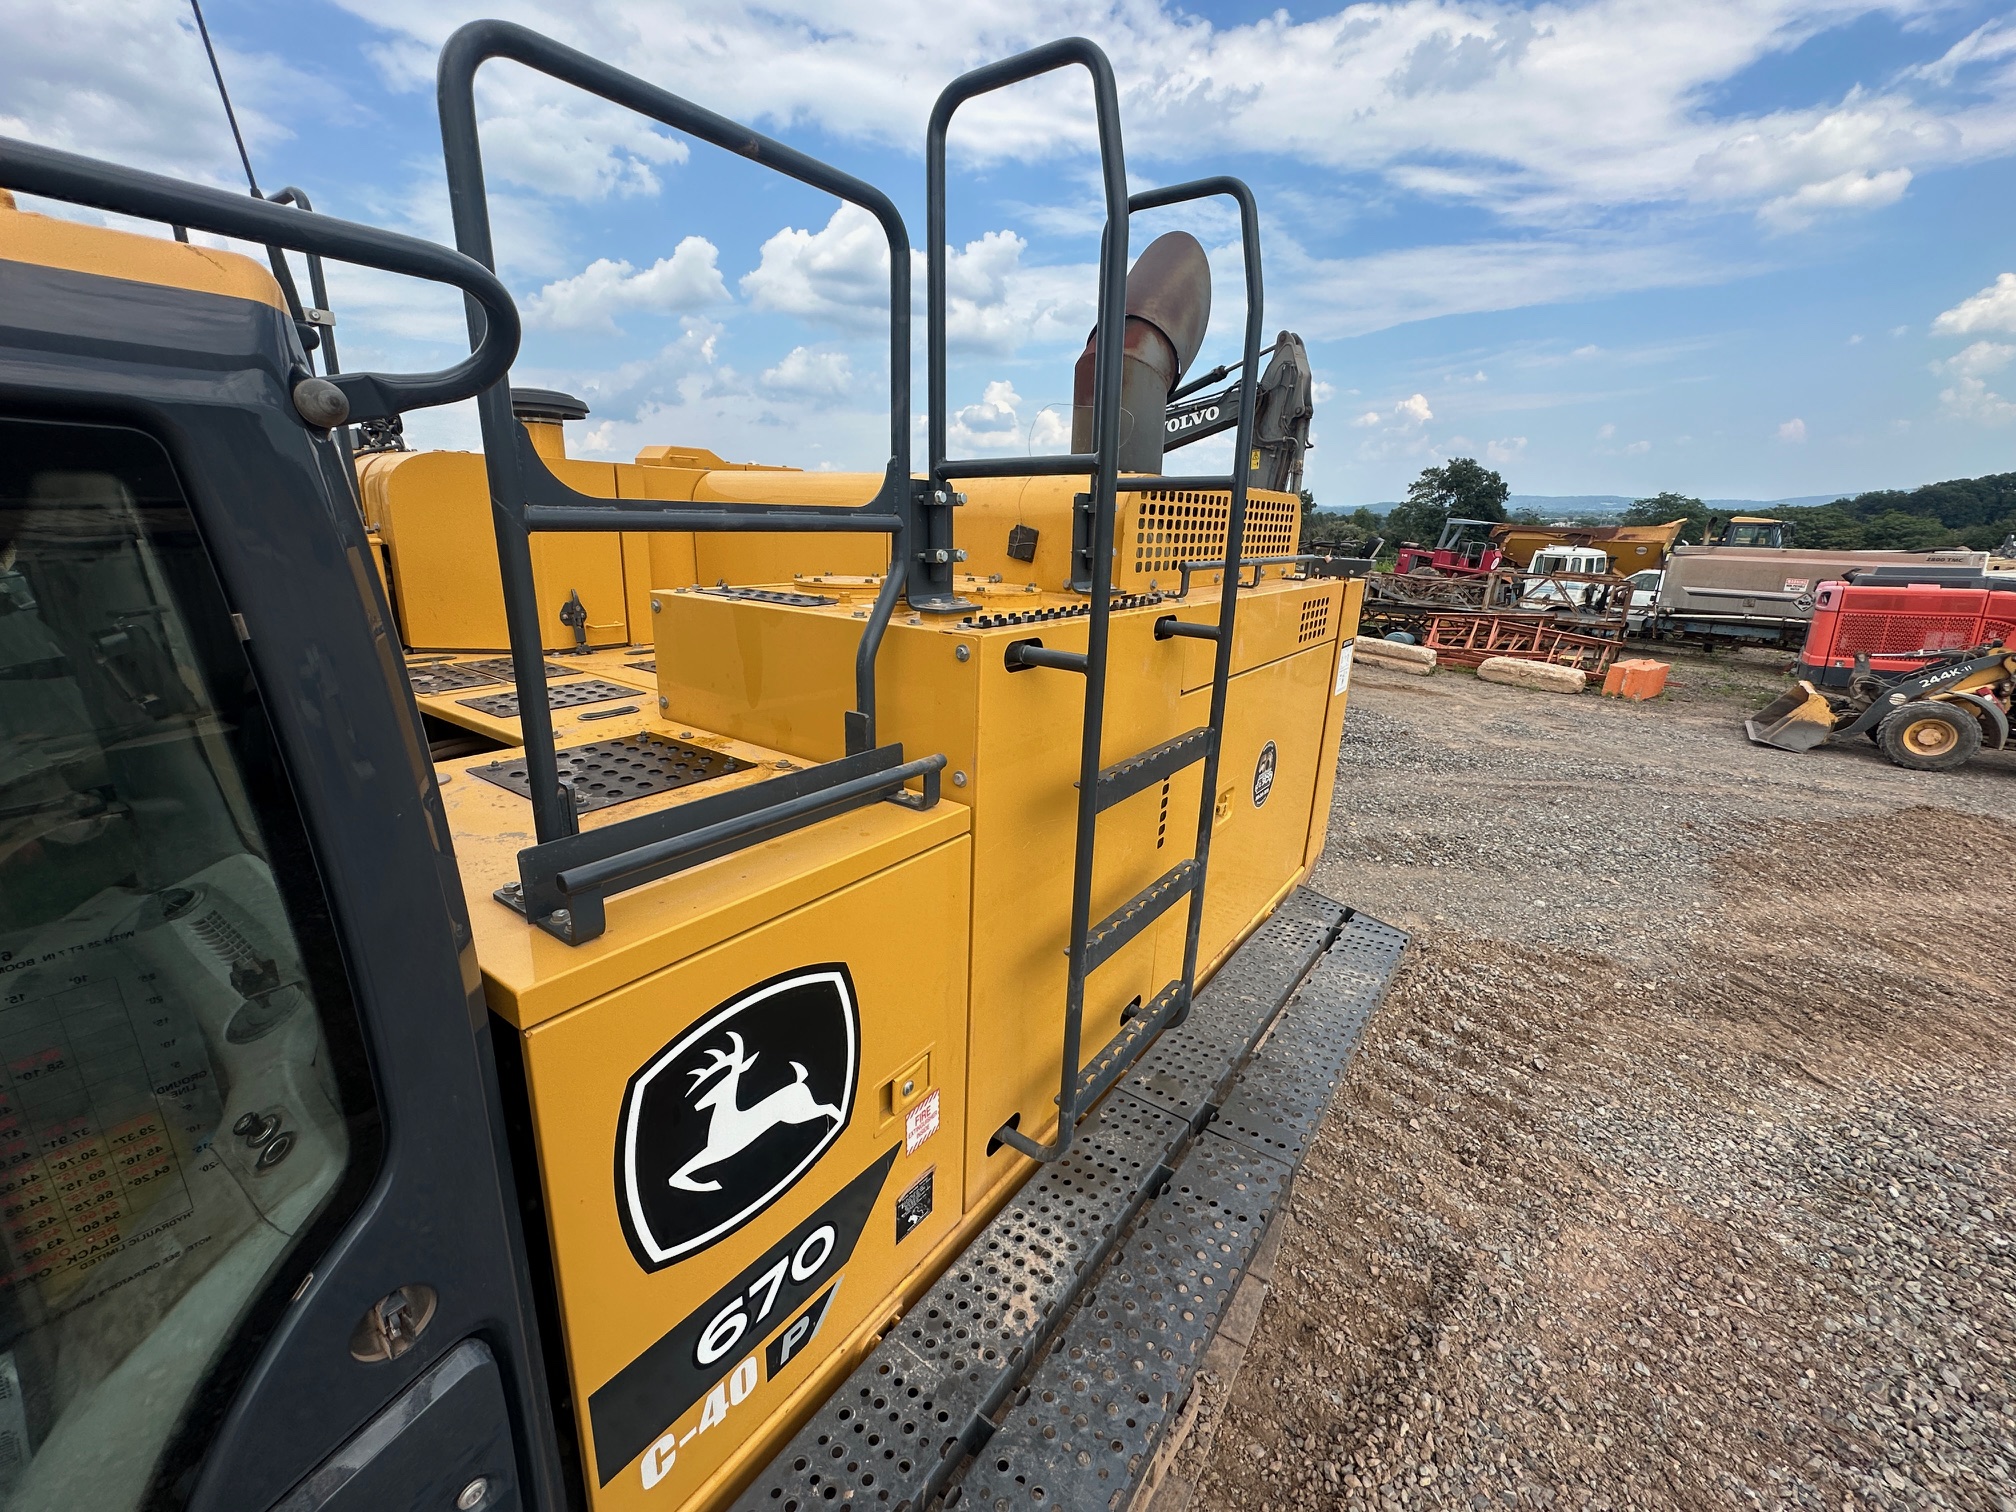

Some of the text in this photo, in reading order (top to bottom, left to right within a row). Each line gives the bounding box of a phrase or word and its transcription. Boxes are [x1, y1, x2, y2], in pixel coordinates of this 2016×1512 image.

[1164, 406, 1220, 432] OLVO
[914, 1105, 932, 1127] FIRE
[696, 1224, 837, 1366] 670
[640, 1315, 811, 1491] C-40 P
